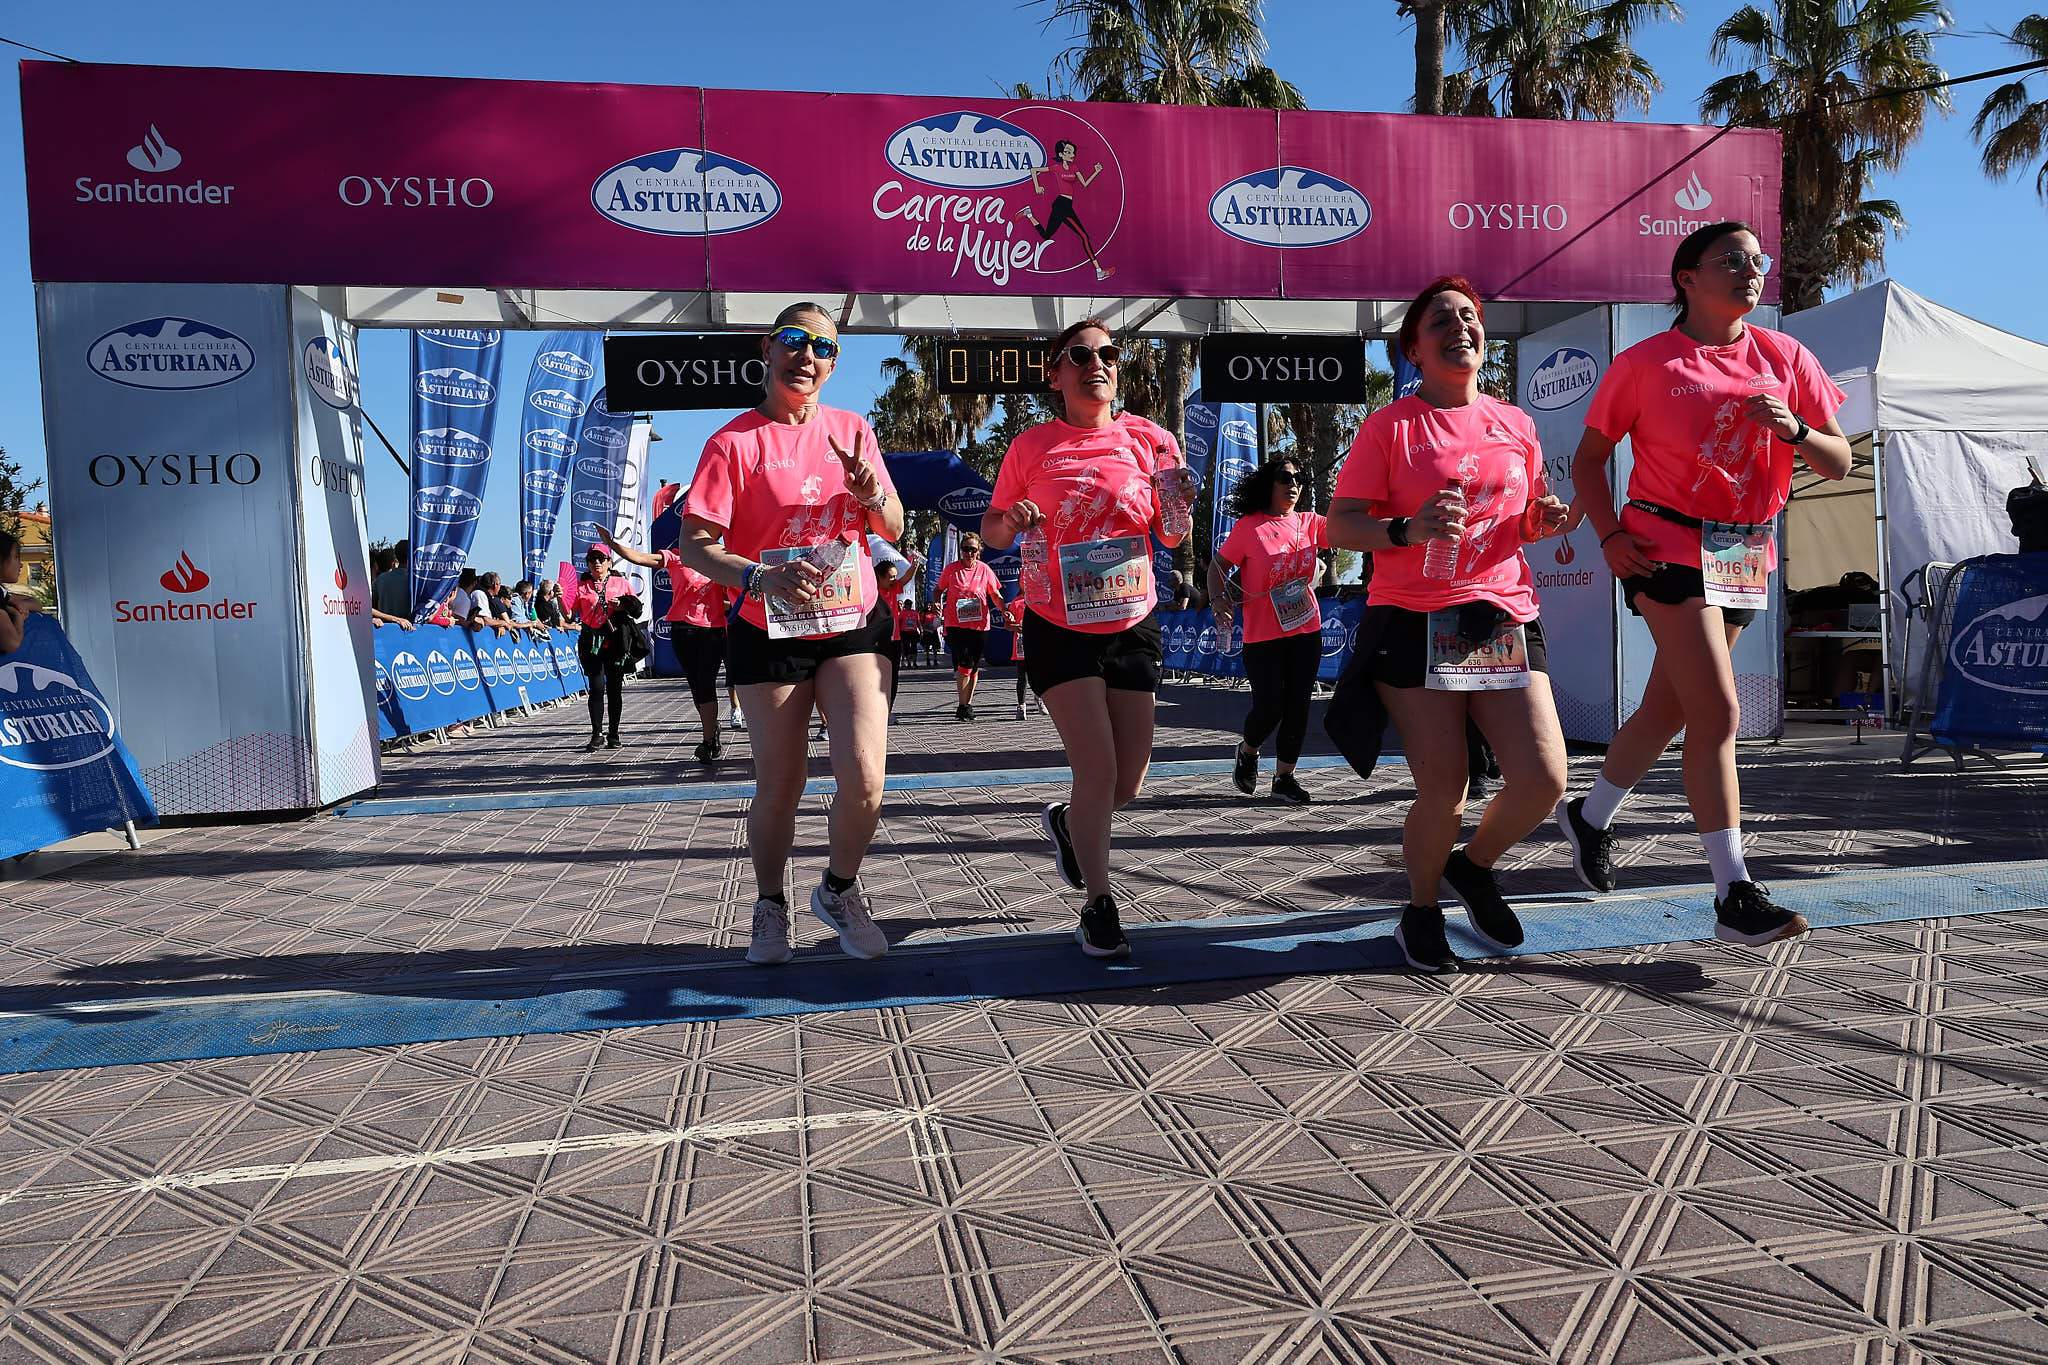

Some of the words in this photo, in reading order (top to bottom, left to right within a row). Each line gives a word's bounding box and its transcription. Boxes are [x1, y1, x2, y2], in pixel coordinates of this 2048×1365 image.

[898, 137, 1034, 171] ASTURIANA
[923, 137, 974, 146] CENTRAL
[978, 139, 1029, 148] LECHERA
[75, 177, 235, 205] Santander
[338, 175, 494, 208] OYSHO
[635, 178, 695, 187] CENTRAL
[607, 179, 768, 213] ASTURIANA
[872, 180, 1008, 226] Carrera
[1246, 194, 1297, 203] CENTRAL
[1302, 194, 1353, 203] LECHERA
[1222, 195, 1360, 227] ASTURIANA
[1448, 202, 1568, 231] OYSHO
[906, 224, 931, 251] de
[936, 224, 954, 253] la
[951, 220, 1055, 286] Mujer
[101, 344, 243, 372] ASTURIANA
[125, 341, 177, 350] CENTRAL
[183, 342, 237, 351] LECHERA
[542, 356, 590, 378] ASTURIANA
[637, 359, 768, 386] OYSHO
[1228, 355, 1343, 382] OYSHO
[417, 377, 491, 401] ASTURIANA
[1531, 369, 1593, 402] ASTURIANA
[1671, 383, 1714, 397] OYSHO
[534, 394, 583, 415] ASTURIANA
[417, 437, 485, 460] ASTURIANA
[89, 453, 262, 488] OYSHO
[311, 455, 360, 498] OYSHO
[756, 460, 796, 474] OYSHO
[1536, 570, 1594, 589] Santander
[1715, 560, 1742, 575] 016
[1093, 574, 1126, 590] 016
[115, 598, 258, 623] Santander
[322, 593, 362, 617] Santander
[780, 623, 811, 633] OYSHO
[1434, 665, 1456, 673] CARRERA
[1495, 665, 1522, 673] VALENCIA
[1438, 677, 1468, 685] OYSHO
